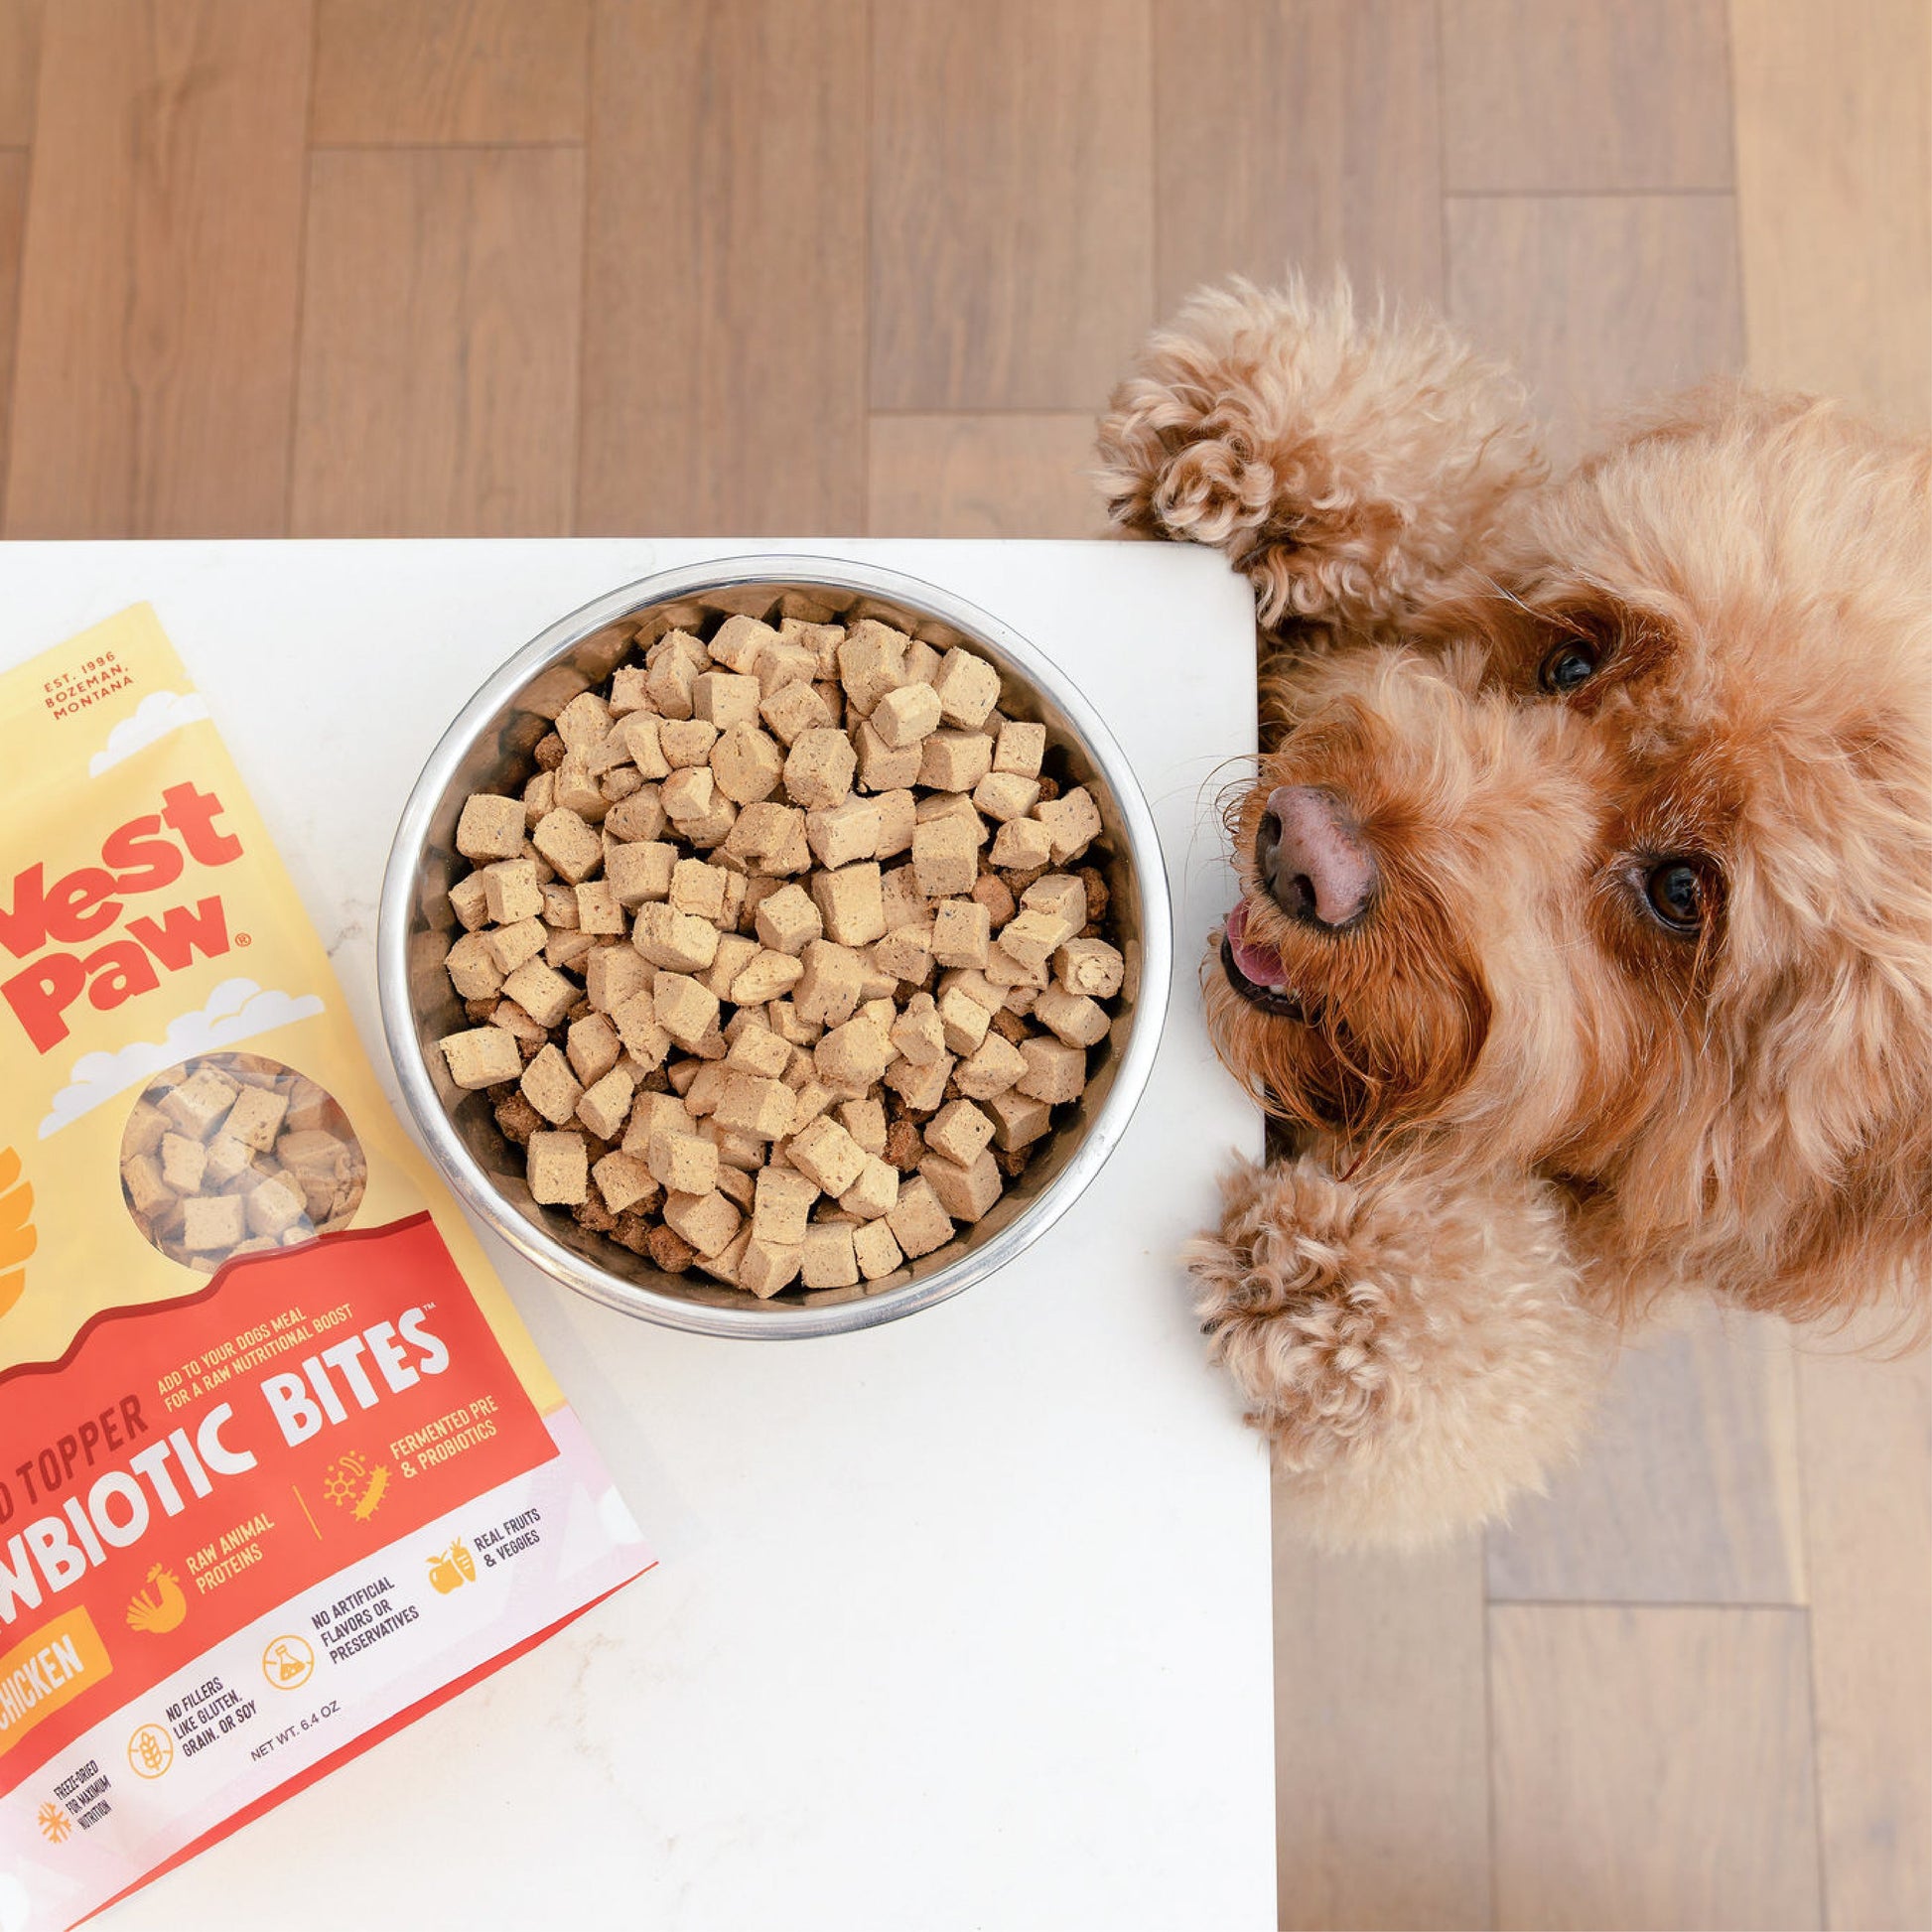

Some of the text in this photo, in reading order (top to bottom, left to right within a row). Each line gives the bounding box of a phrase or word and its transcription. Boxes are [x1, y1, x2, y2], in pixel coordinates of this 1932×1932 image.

[44, 651, 116, 693] EST. 1996
[53, 675, 134, 721] MONTANA
[157, 1307, 308, 1396] ADD TO YOUR DOGS MEAL
[164, 1303, 354, 1413] FOR A RAW NUTRITIONAL BOOST
[15, 1394, 149, 1505] TOPPER
[390, 1395, 498, 1460] FERMENTED PRE
[400, 1420, 497, 1478] & PROBIOTICS
[186, 1512, 275, 1576] RAW ANIMAL
[474, 1508, 541, 1552] REAL FRUITS
[483, 1530, 540, 1568] & VEGGIES
[196, 1543, 263, 1594] PROTEINS
[311, 1577, 395, 1630] NO ARTIFICIAL
[320, 1598, 393, 1648] FLAVORS OR
[329, 1604, 420, 1665] PRESERVATIVES
[165, 1676, 224, 1723] NO FILLERS
[218, 1715, 237, 1734] OR
[235, 1699, 257, 1725] SOY
[172, 1716, 199, 1740] LIKE
[250, 1700, 342, 1762] NET WT. 6.4 OZ
[53, 1759, 99, 1801] FREEZE-DRIED
[65, 1798, 83, 1816] FOR
